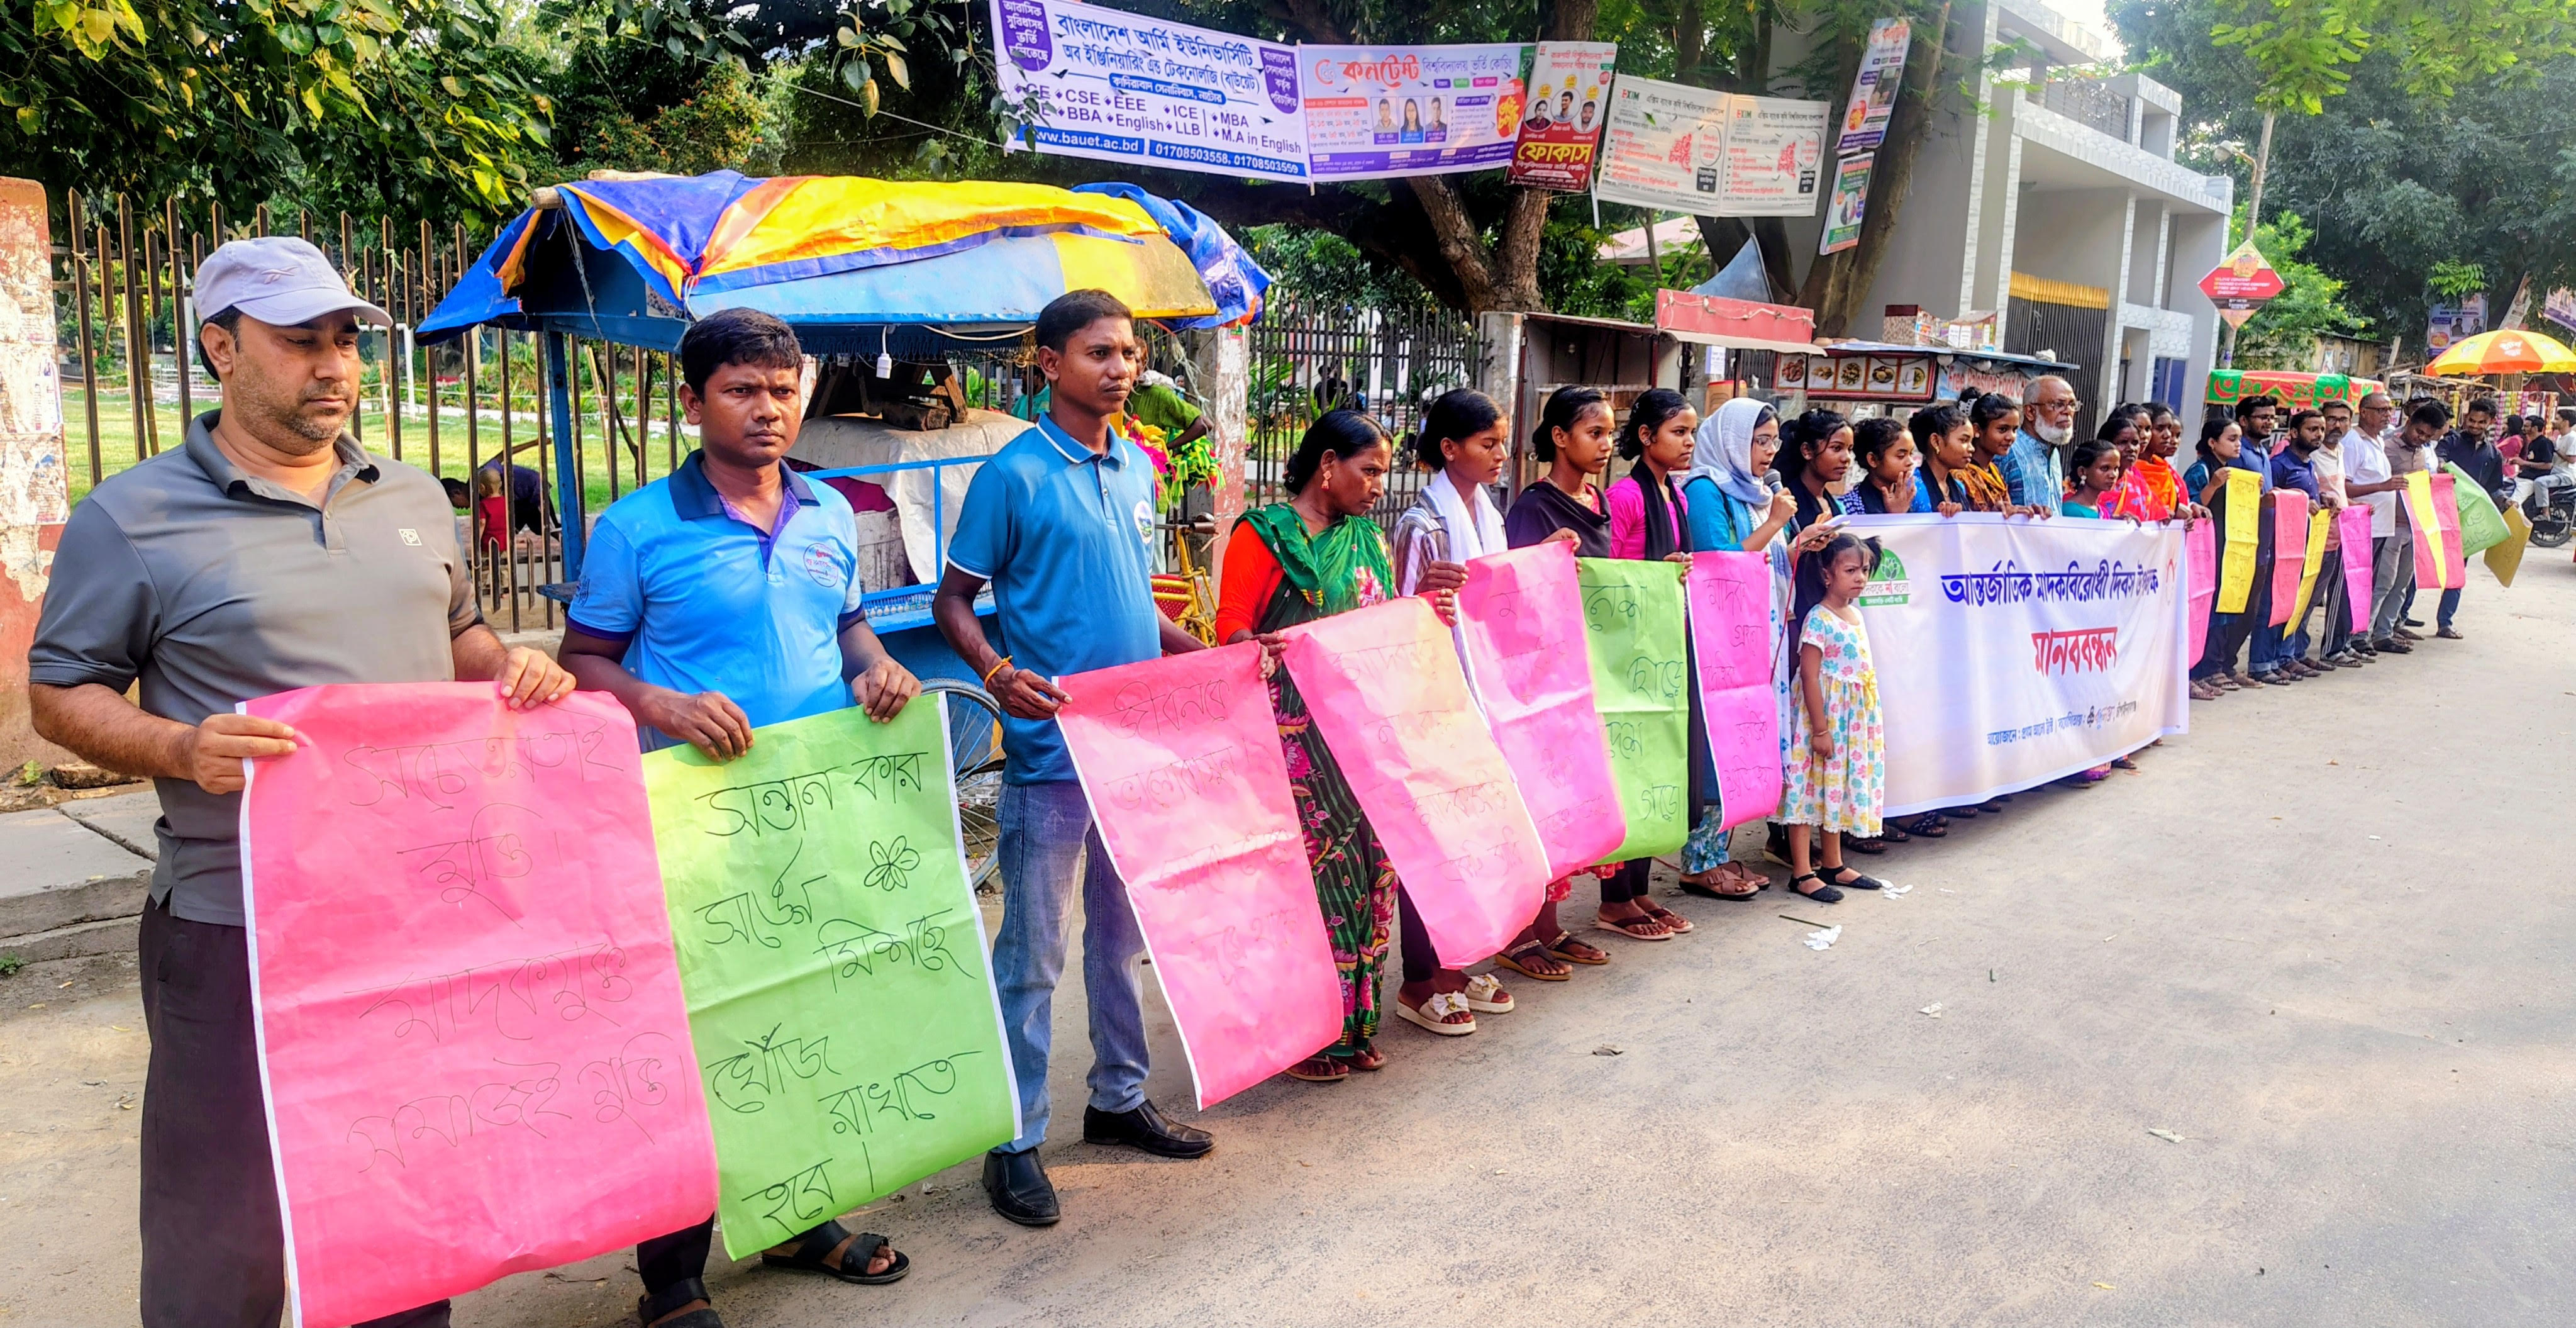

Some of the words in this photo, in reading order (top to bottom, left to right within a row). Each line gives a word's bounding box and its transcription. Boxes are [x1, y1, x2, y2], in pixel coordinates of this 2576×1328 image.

[1015, 31, 1038, 44] ভর্তি
[1054, 13, 1131, 46] বাংলাদেশ
[1132, 26, 1171, 53] আর্মি
[1172, 31, 1253, 68] ইউনিভার্সিটি
[1062, 44, 1080, 64] অব
[1164, 58, 1218, 87] টেকনোলজি
[1421, 57, 1468, 73] বিশ্ববিদ্যালয়
[1470, 54, 1489, 70] ভর্তি
[1066, 89, 1101, 106] CSE
[1114, 96, 1146, 112] EEE
[1174, 104, 1199, 120] ICE
[1220, 111, 1249, 128] MBA
[1621, 89, 1640, 101] EXIM
[1736, 109, 1752, 119] EXIM
[1067, 106, 1102, 123] BBA
[1116, 113, 1165, 132] English
[1175, 121, 1201, 136] LLB
[1222, 128, 1244, 143] M.A
[1248, 132, 1258, 146] in
[1262, 135, 1302, 153] English
[1234, 155, 1299, 174] 01708503559
[1517, 142, 1594, 164] ফোকাস
[1941, 560, 2032, 607] আন্তর্জাতিক
[2035, 559, 2109, 603] মাদকবিরোধী
[2110, 561, 2135, 600] দিবস
[1580, 584, 1649, 632] নেশা
[2031, 627, 2118, 678] মানববন্ধন
[694, 765, 843, 837] সন্তান
[852, 751, 929, 805] কার
[705, 1022, 842, 1113] খোঁজ
[818, 1050, 984, 1135] রাখতে
